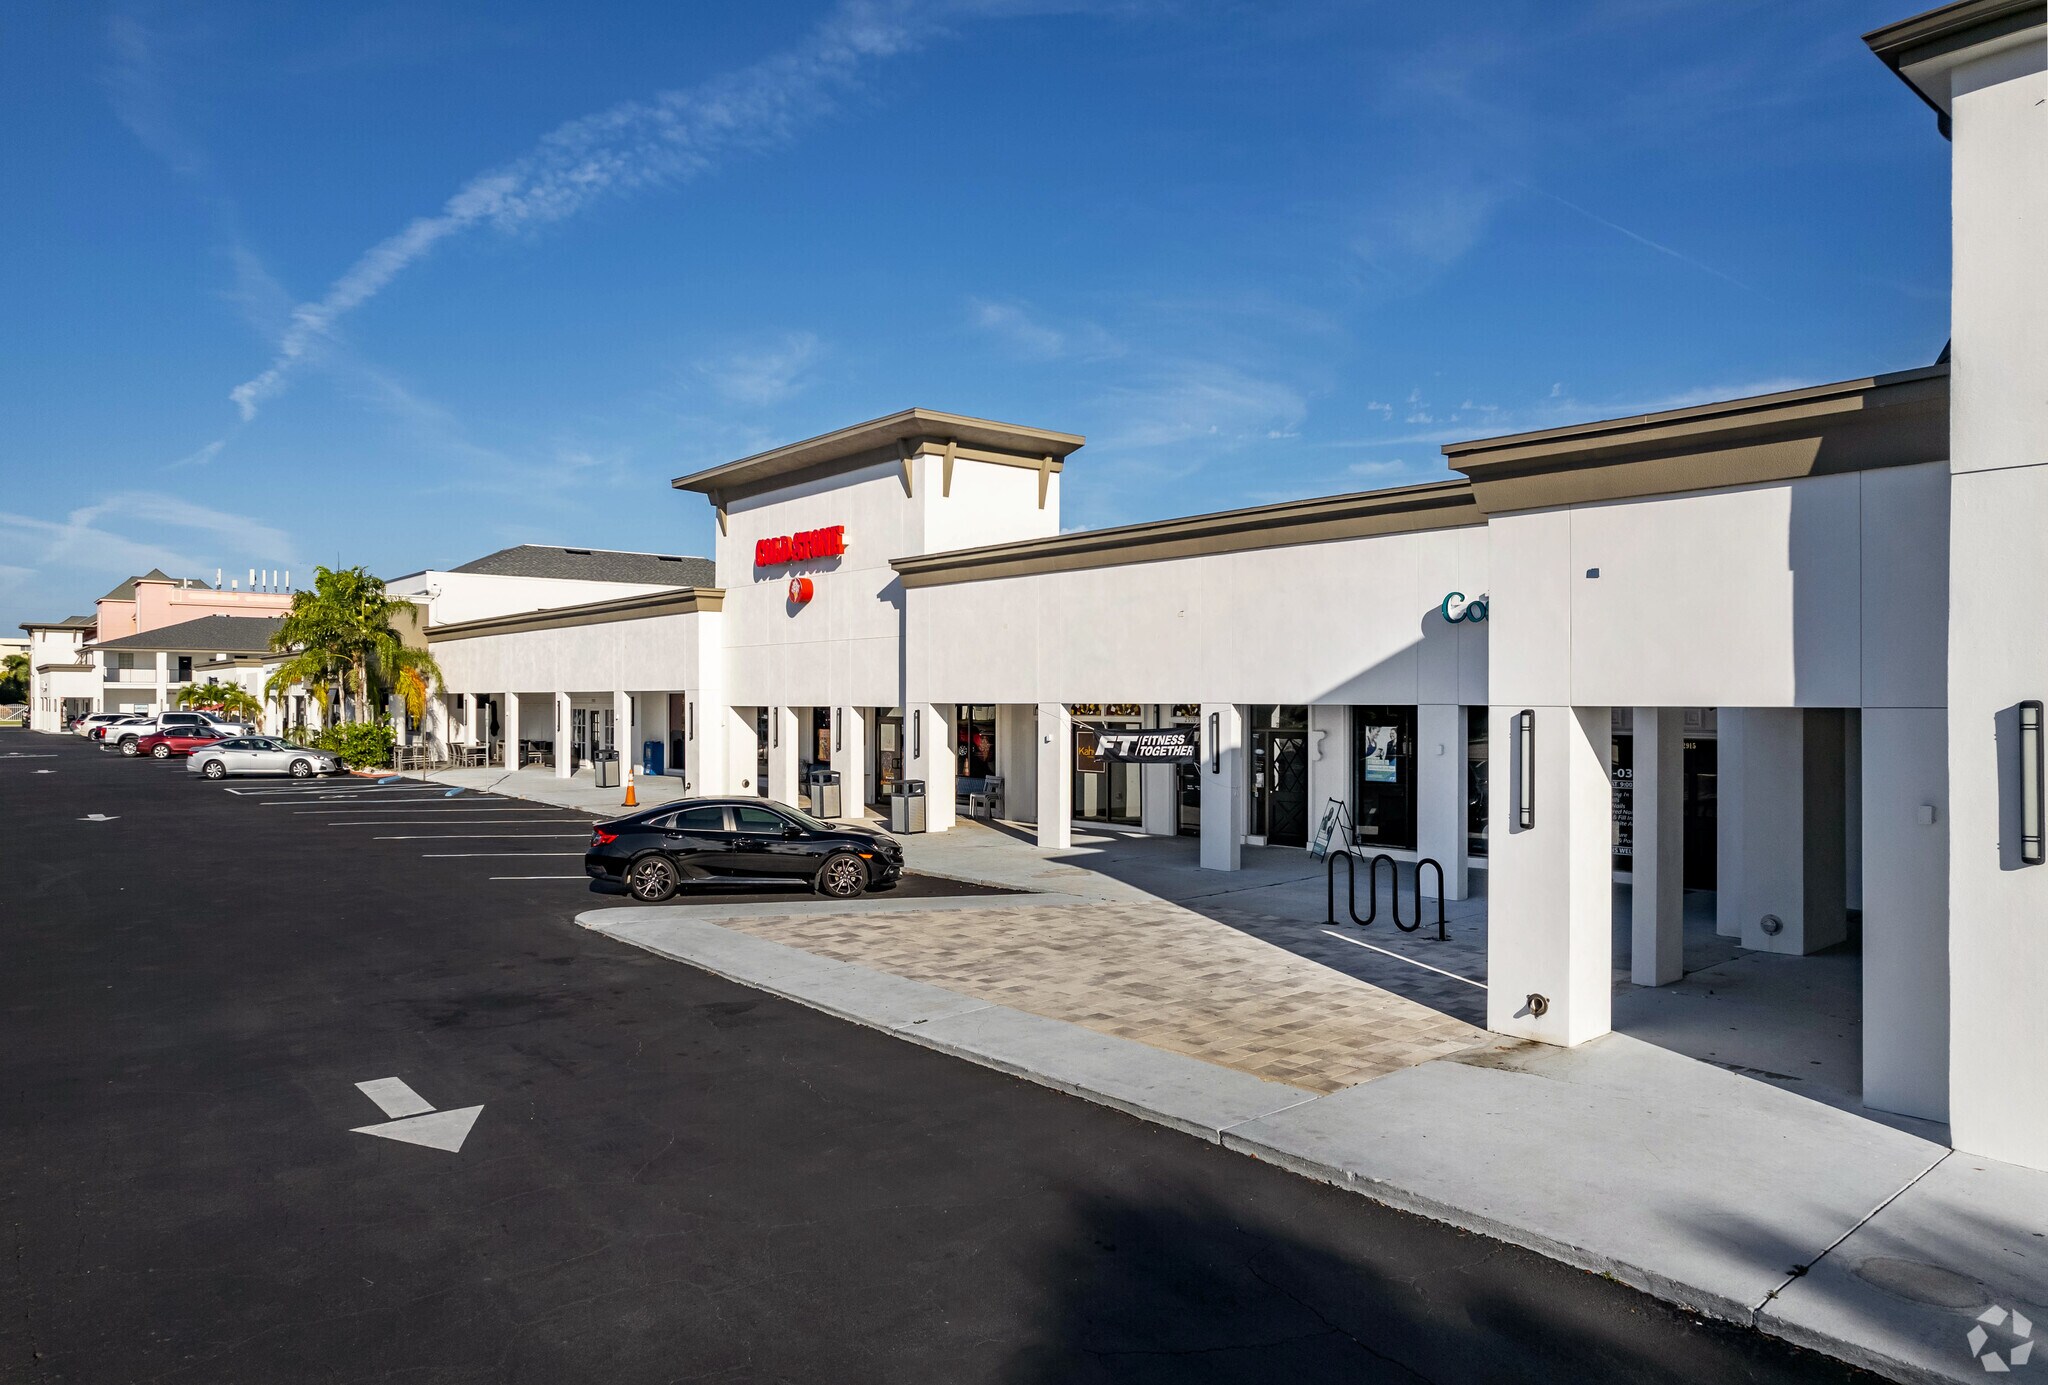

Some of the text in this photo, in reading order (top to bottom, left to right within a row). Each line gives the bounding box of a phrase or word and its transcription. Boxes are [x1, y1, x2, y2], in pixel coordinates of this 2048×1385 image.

[1442, 591, 1489, 624] Co
[1141, 734, 1185, 745] FITNESS
[1078, 745, 1095, 756] Kah
[1095, 735, 1139, 756] FT
[1140, 745, 1195, 757] TOGETHER
[1613, 768, 1633, 778] -03
